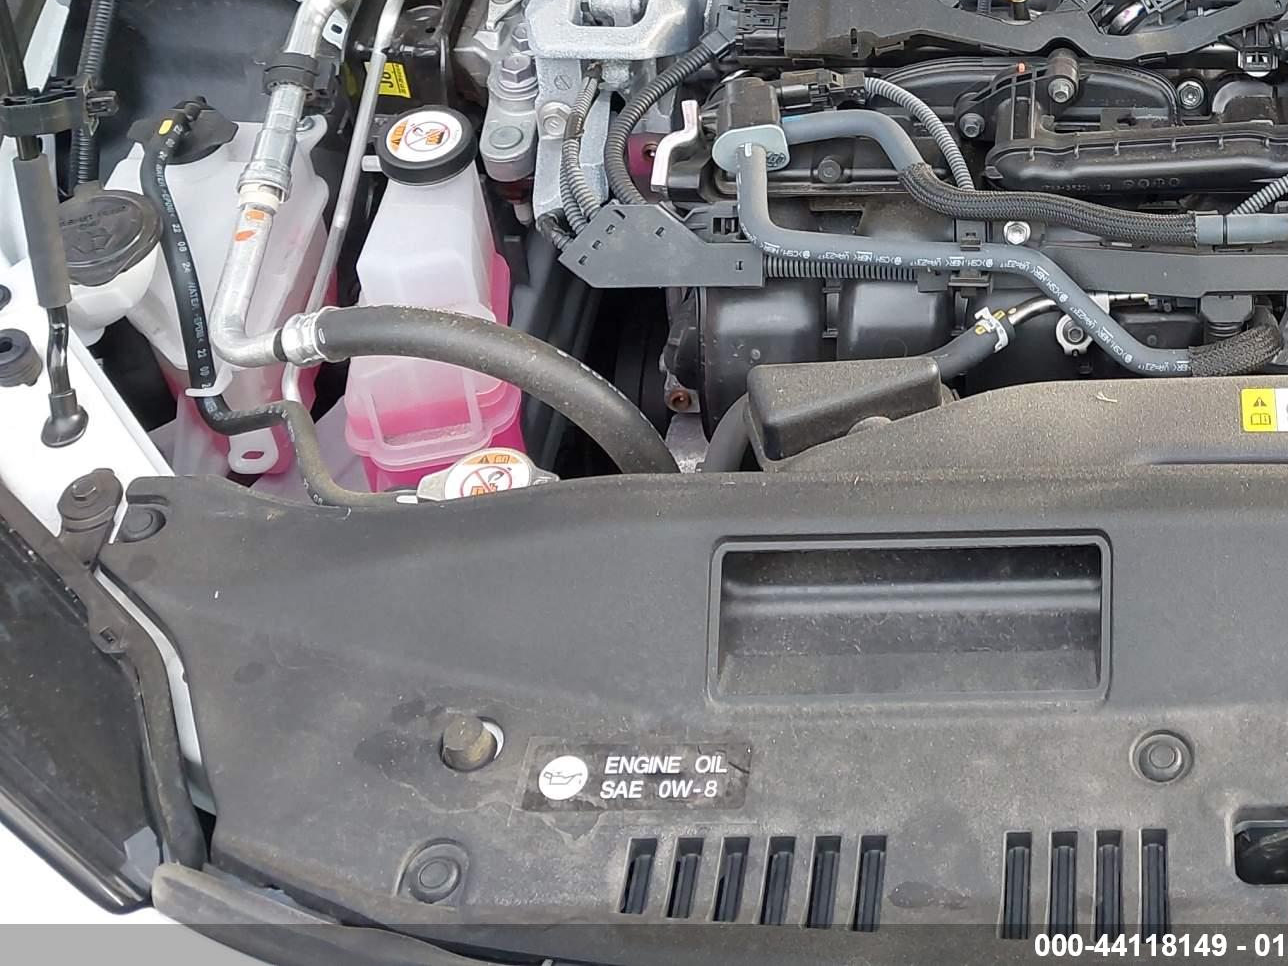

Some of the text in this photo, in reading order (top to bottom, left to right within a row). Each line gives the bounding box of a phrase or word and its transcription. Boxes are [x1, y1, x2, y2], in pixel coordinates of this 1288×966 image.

[604, 755, 728, 774] ENGINE OIL
[600, 780, 718, 799] SAE 0W-8
